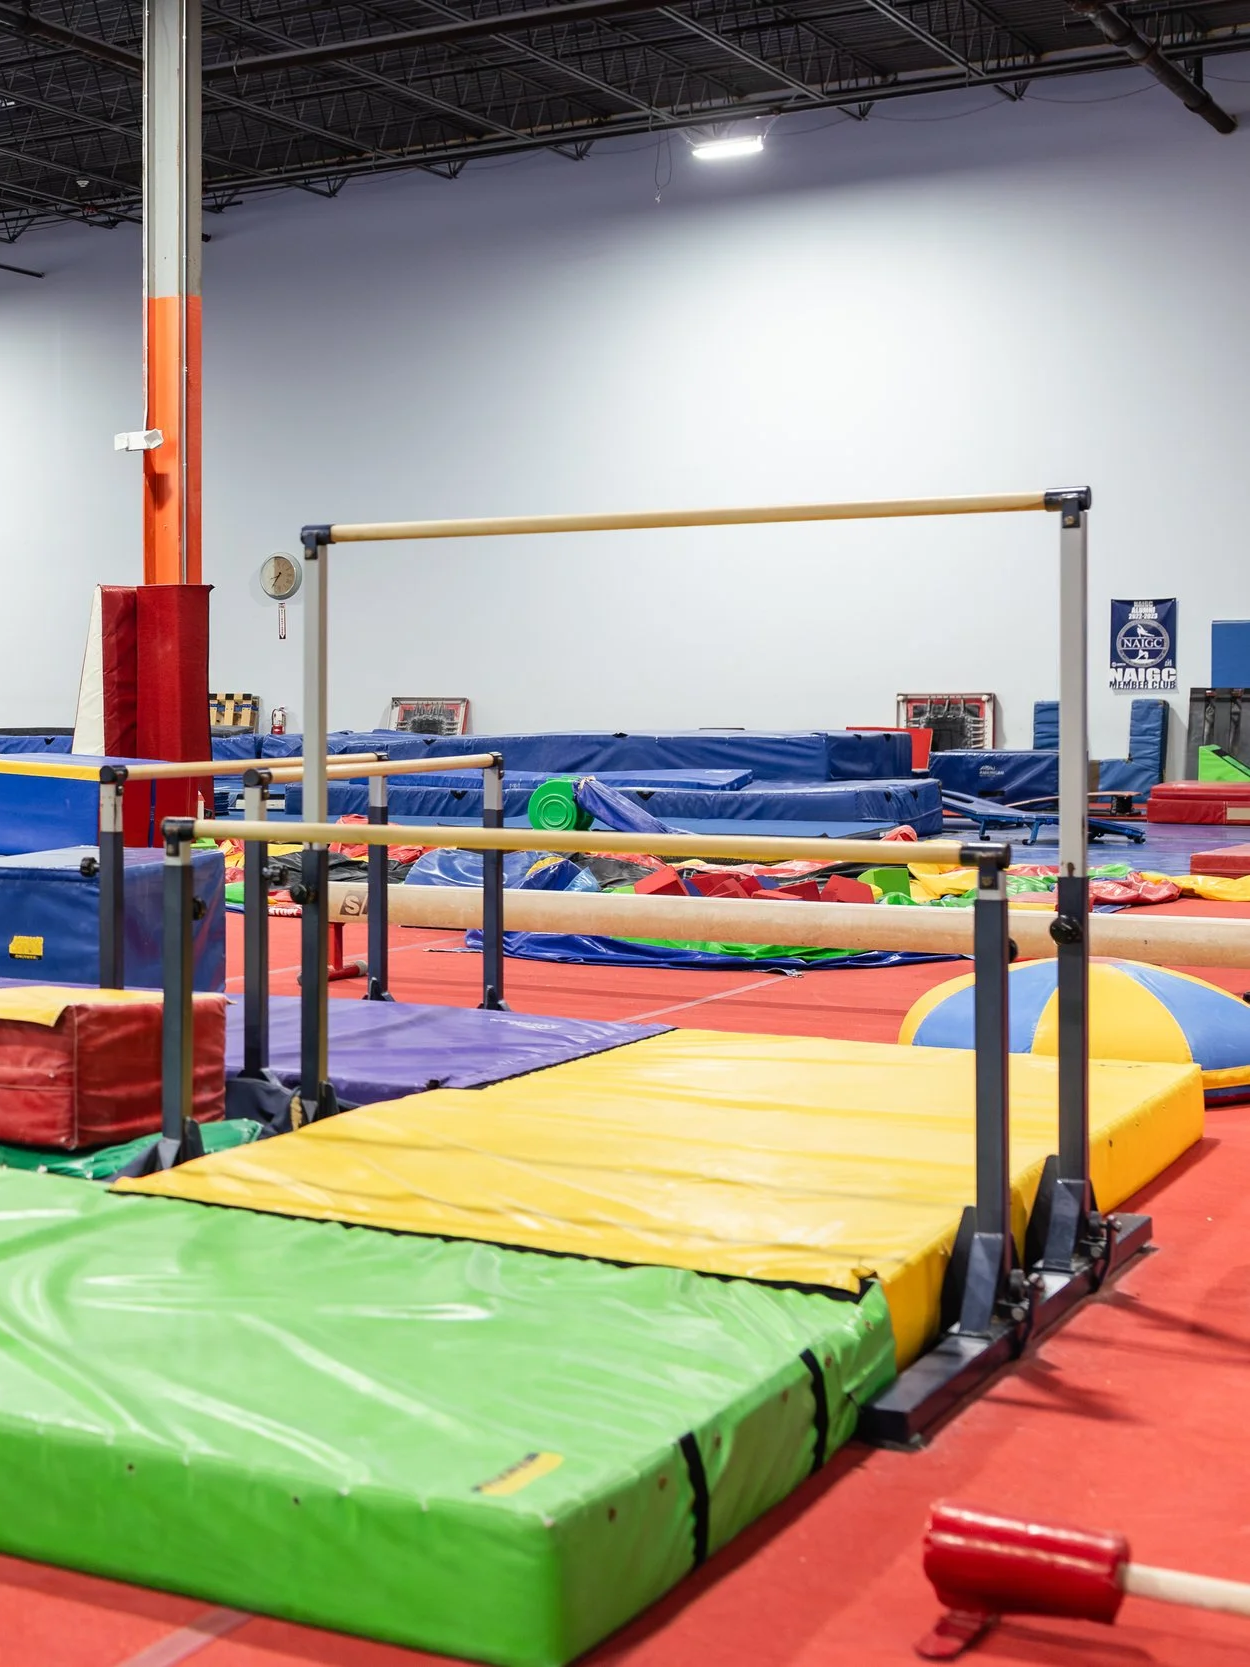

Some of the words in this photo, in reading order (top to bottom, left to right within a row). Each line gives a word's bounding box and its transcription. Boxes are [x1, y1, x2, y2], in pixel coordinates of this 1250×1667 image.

[1123, 638, 1162, 649] NAIGC
[1109, 667, 1177, 682] NAIGC
[1109, 680, 1149, 690] MEMBER
[1151, 680, 1176, 690] CLUB
